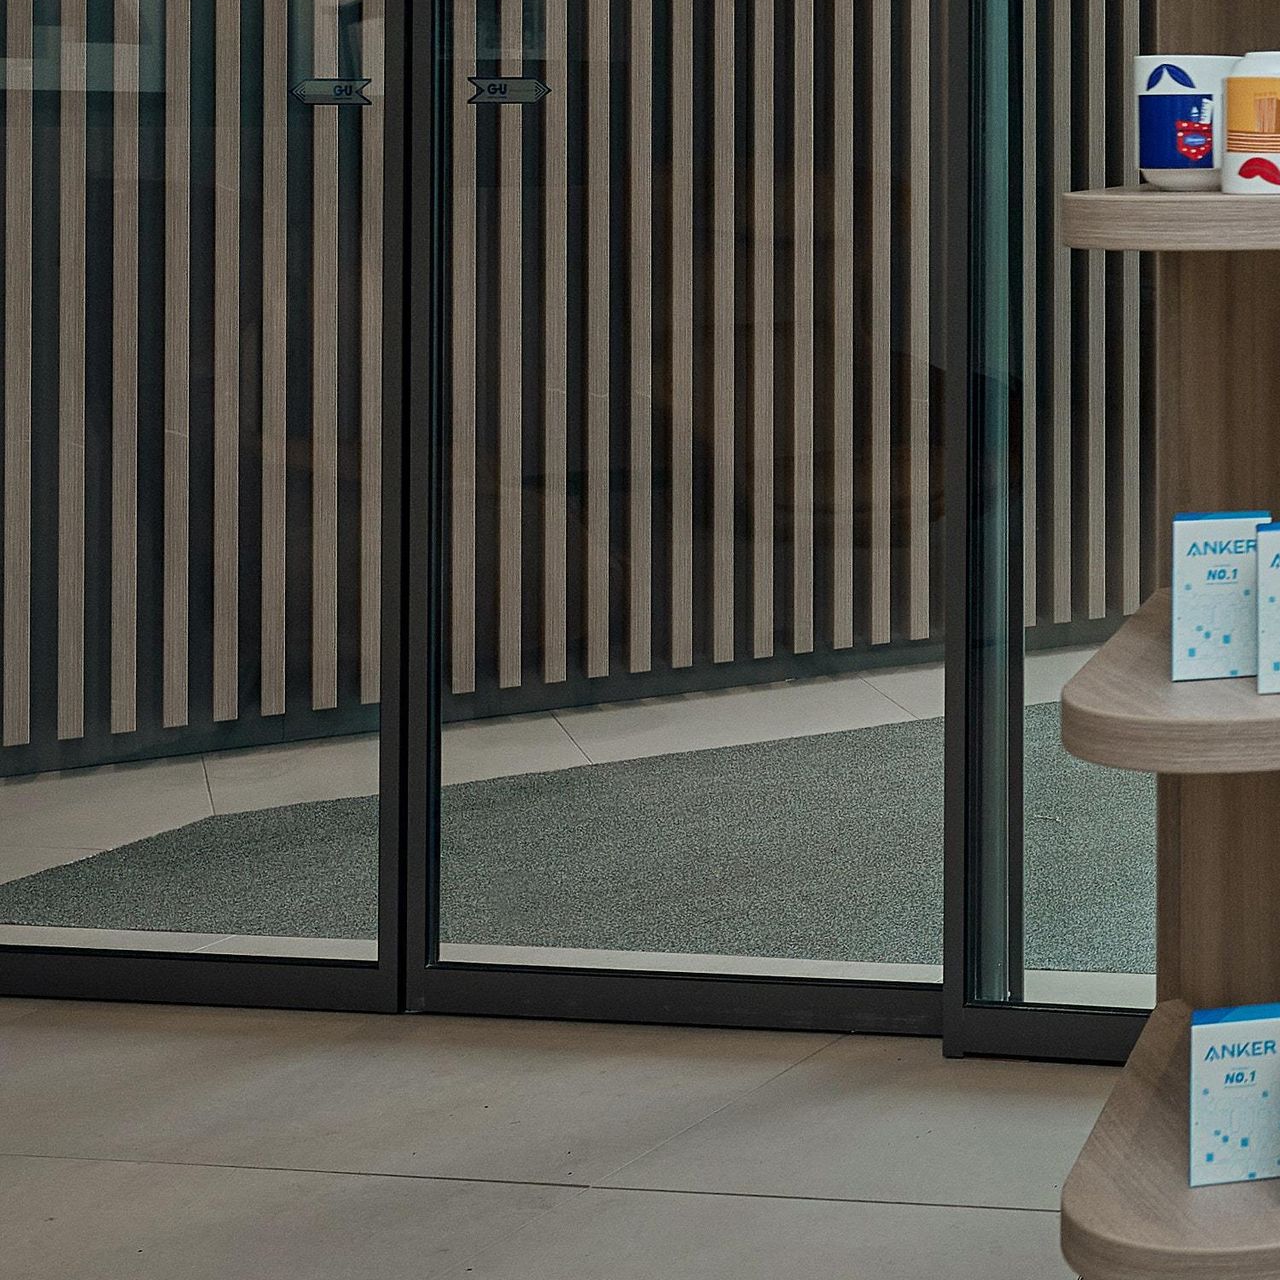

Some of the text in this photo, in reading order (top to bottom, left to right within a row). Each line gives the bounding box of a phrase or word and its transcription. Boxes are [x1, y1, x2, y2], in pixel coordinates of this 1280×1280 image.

[1187, 539, 1258, 557] ANKER
[1206, 568, 1238, 581] NO.1
[1204, 1039, 1277, 1062] ANKER
[1223, 1071, 1256, 1085] NO.1
